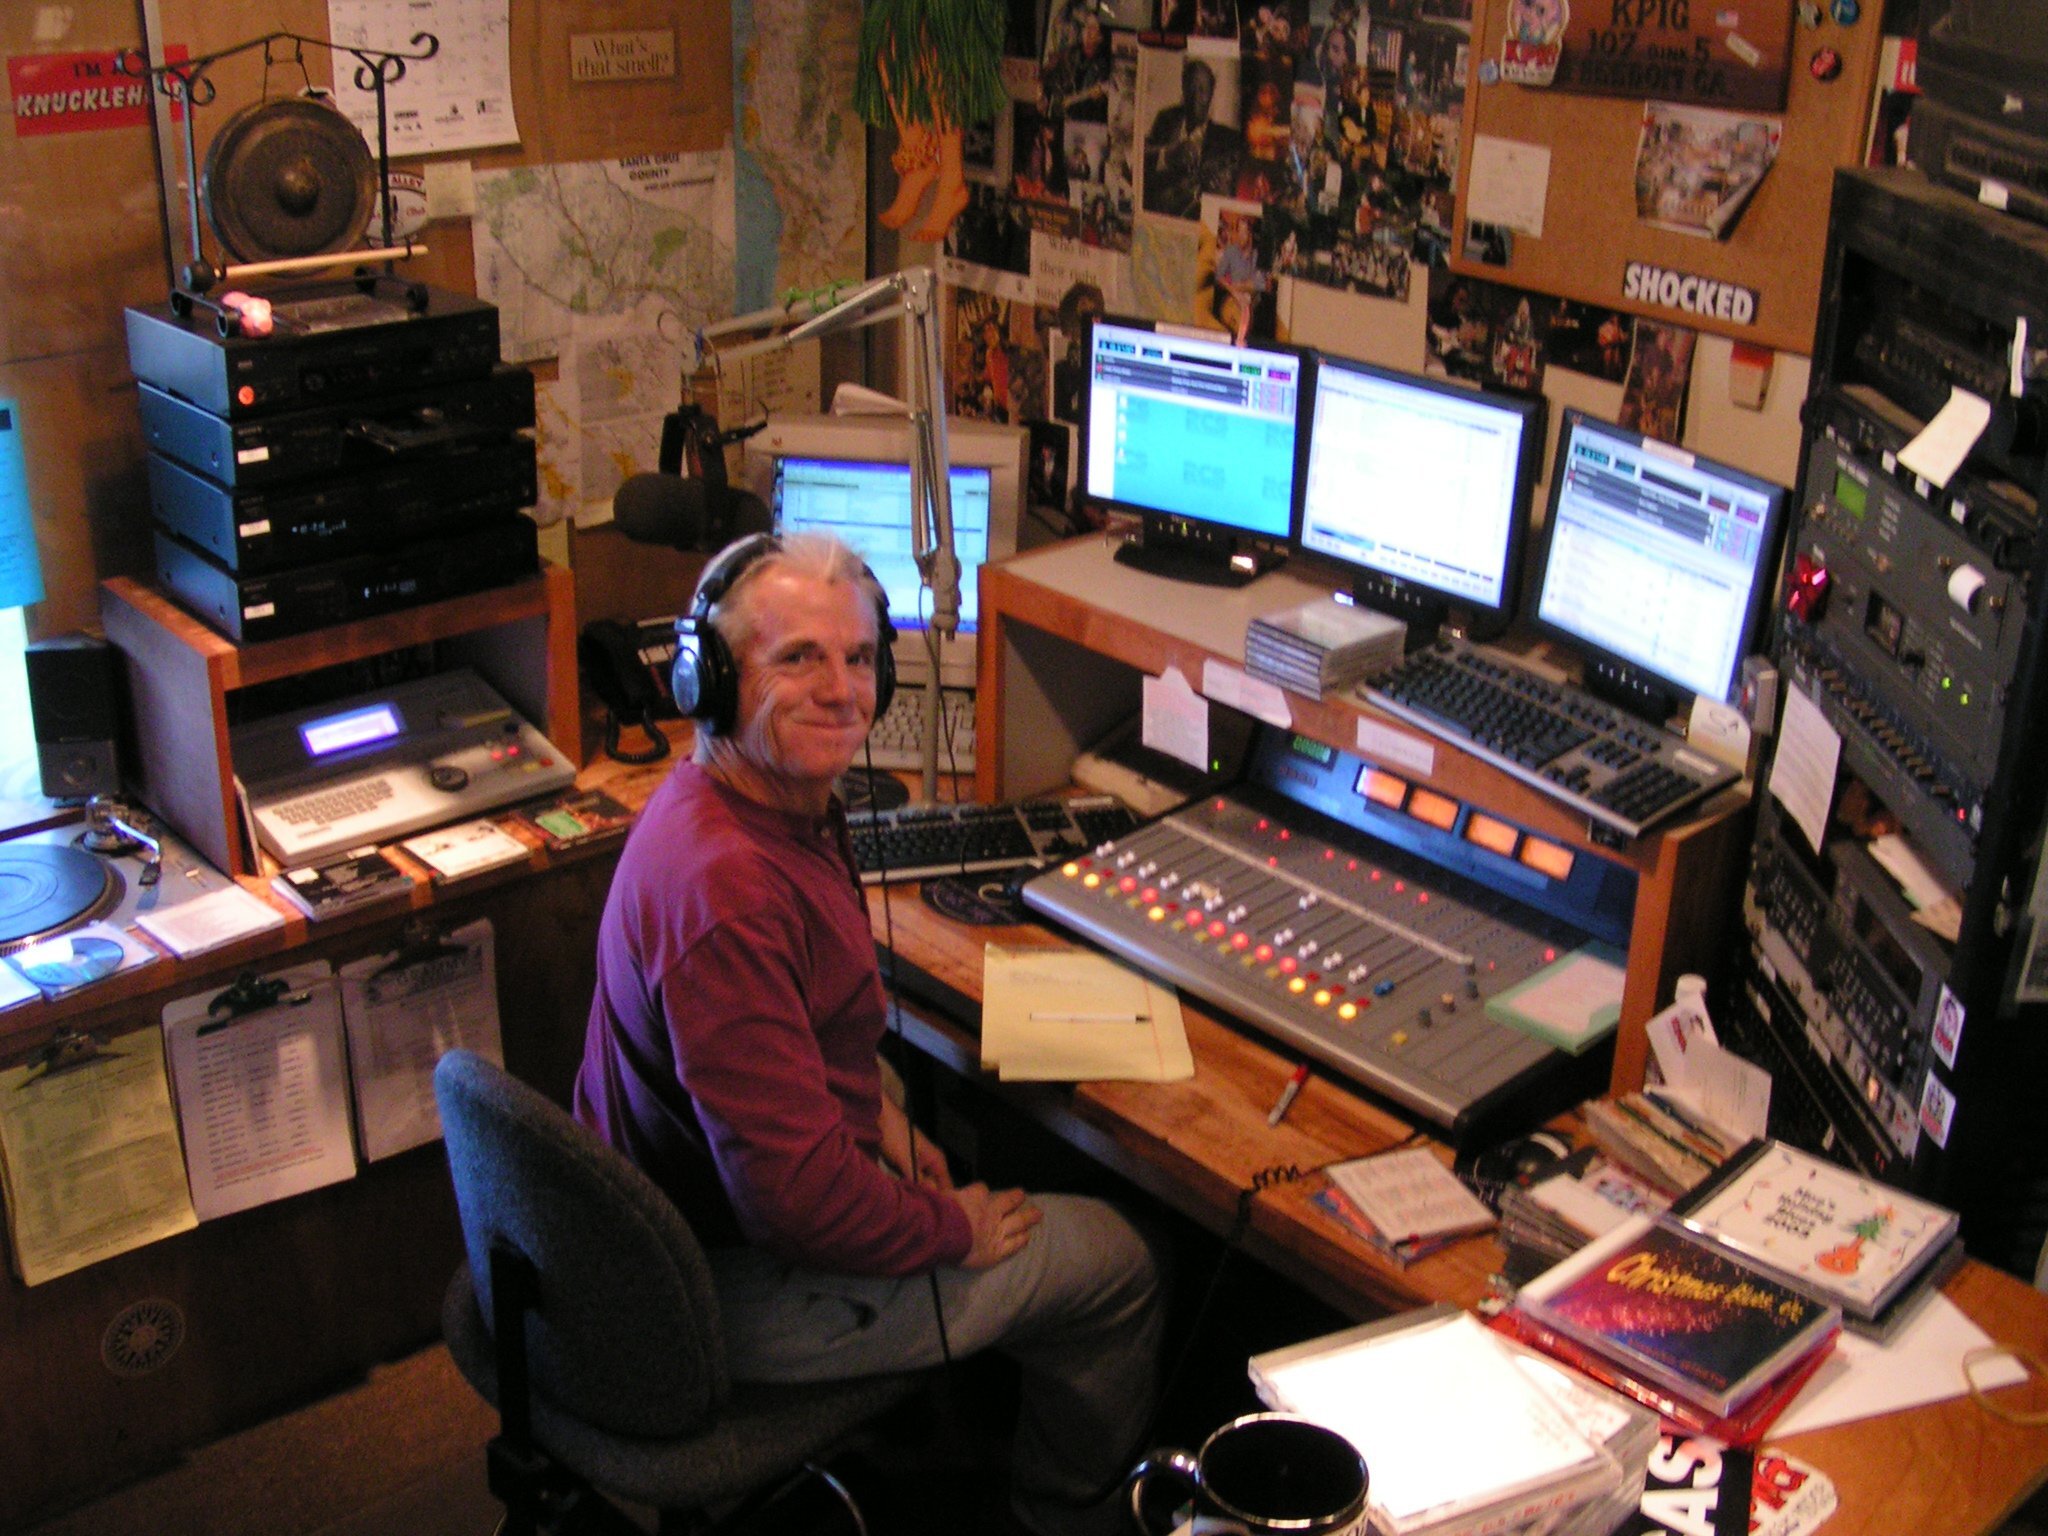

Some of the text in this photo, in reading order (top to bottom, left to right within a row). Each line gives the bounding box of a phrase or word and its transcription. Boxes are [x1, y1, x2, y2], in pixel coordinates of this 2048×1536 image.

[1611, 0, 1690, 31] KPIG
[592, 36, 648, 57] What's
[1587, 28, 1639, 59] 107
[1693, 35, 1712, 66] 5
[73, 62, 101, 79] I'M
[577, 53, 670, 77] that smell?
[629, 168, 670, 181] COUNTY
[1623, 262, 1753, 326] SHOCKED
